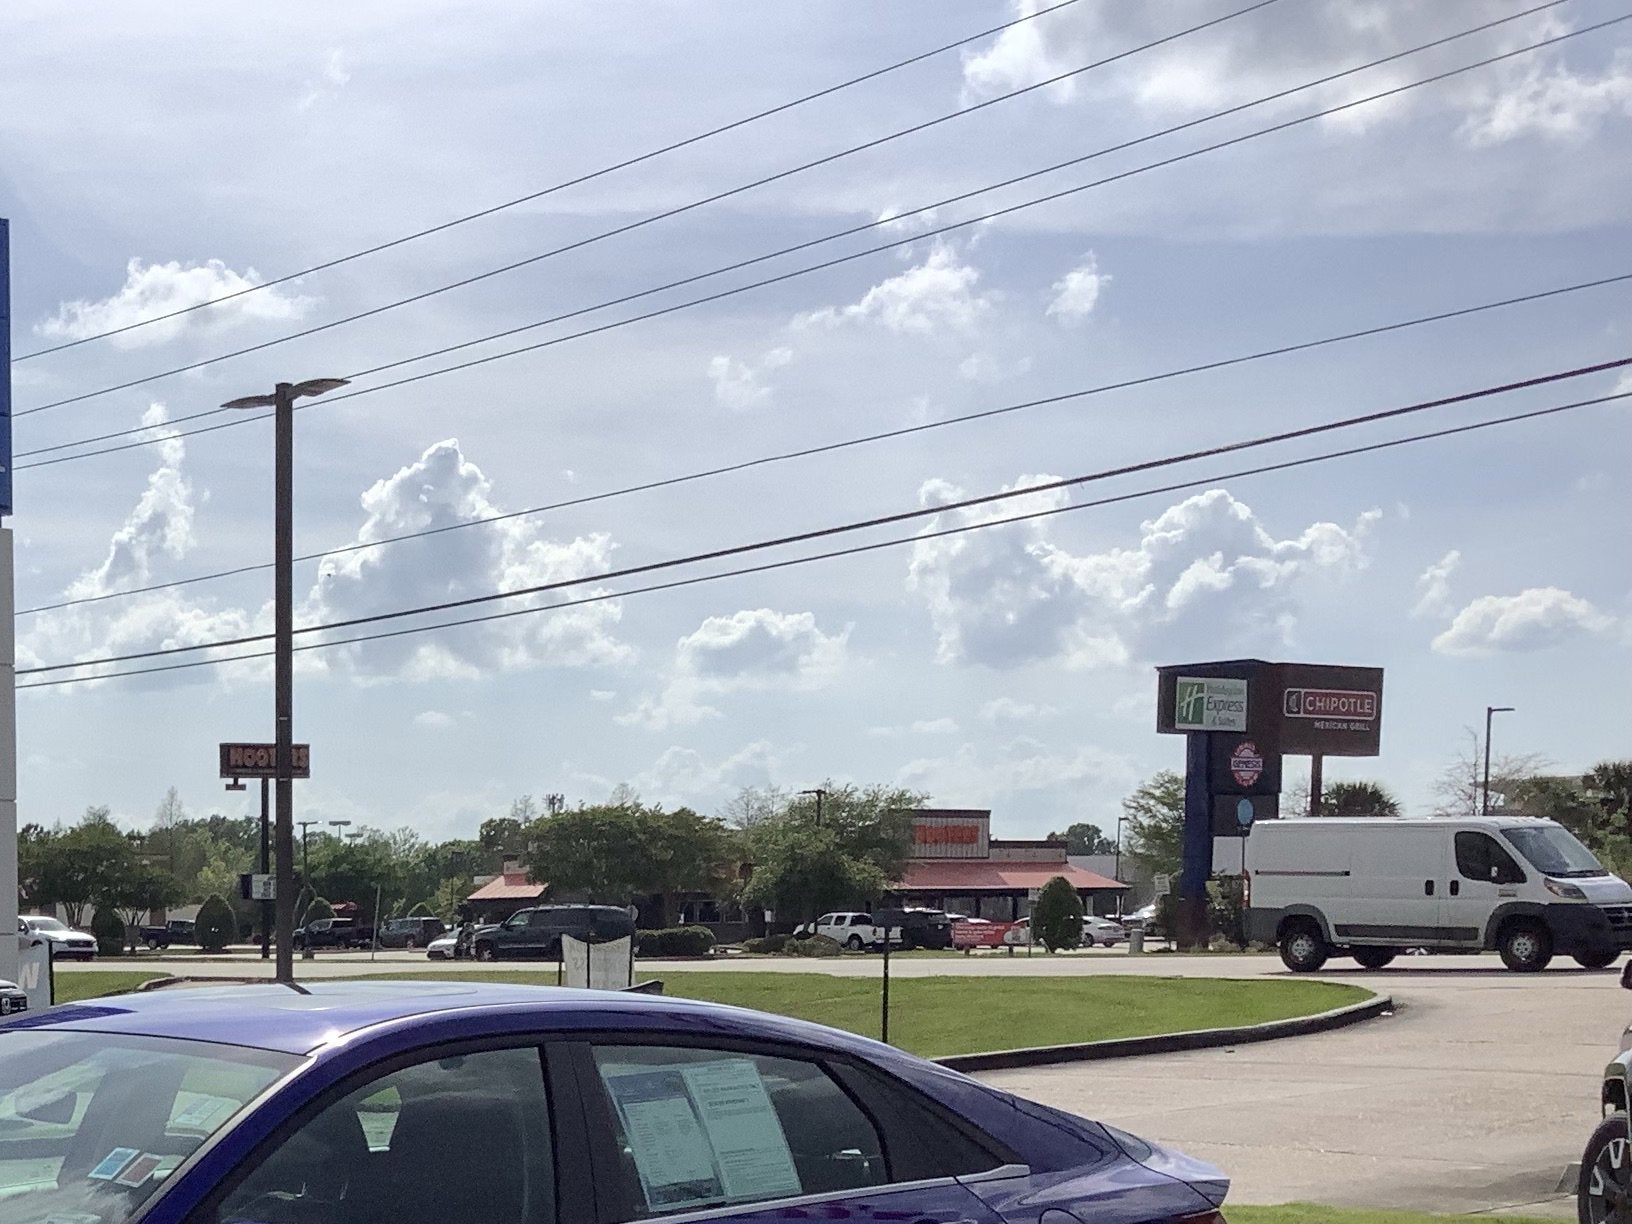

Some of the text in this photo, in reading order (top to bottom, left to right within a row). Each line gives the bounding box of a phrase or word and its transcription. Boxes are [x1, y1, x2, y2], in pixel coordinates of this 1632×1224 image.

[1206, 696, 1244, 714] Express
[1305, 696, 1373, 713] CHIPOTLE
[1314, 721, 1347, 730] MEXICAN
